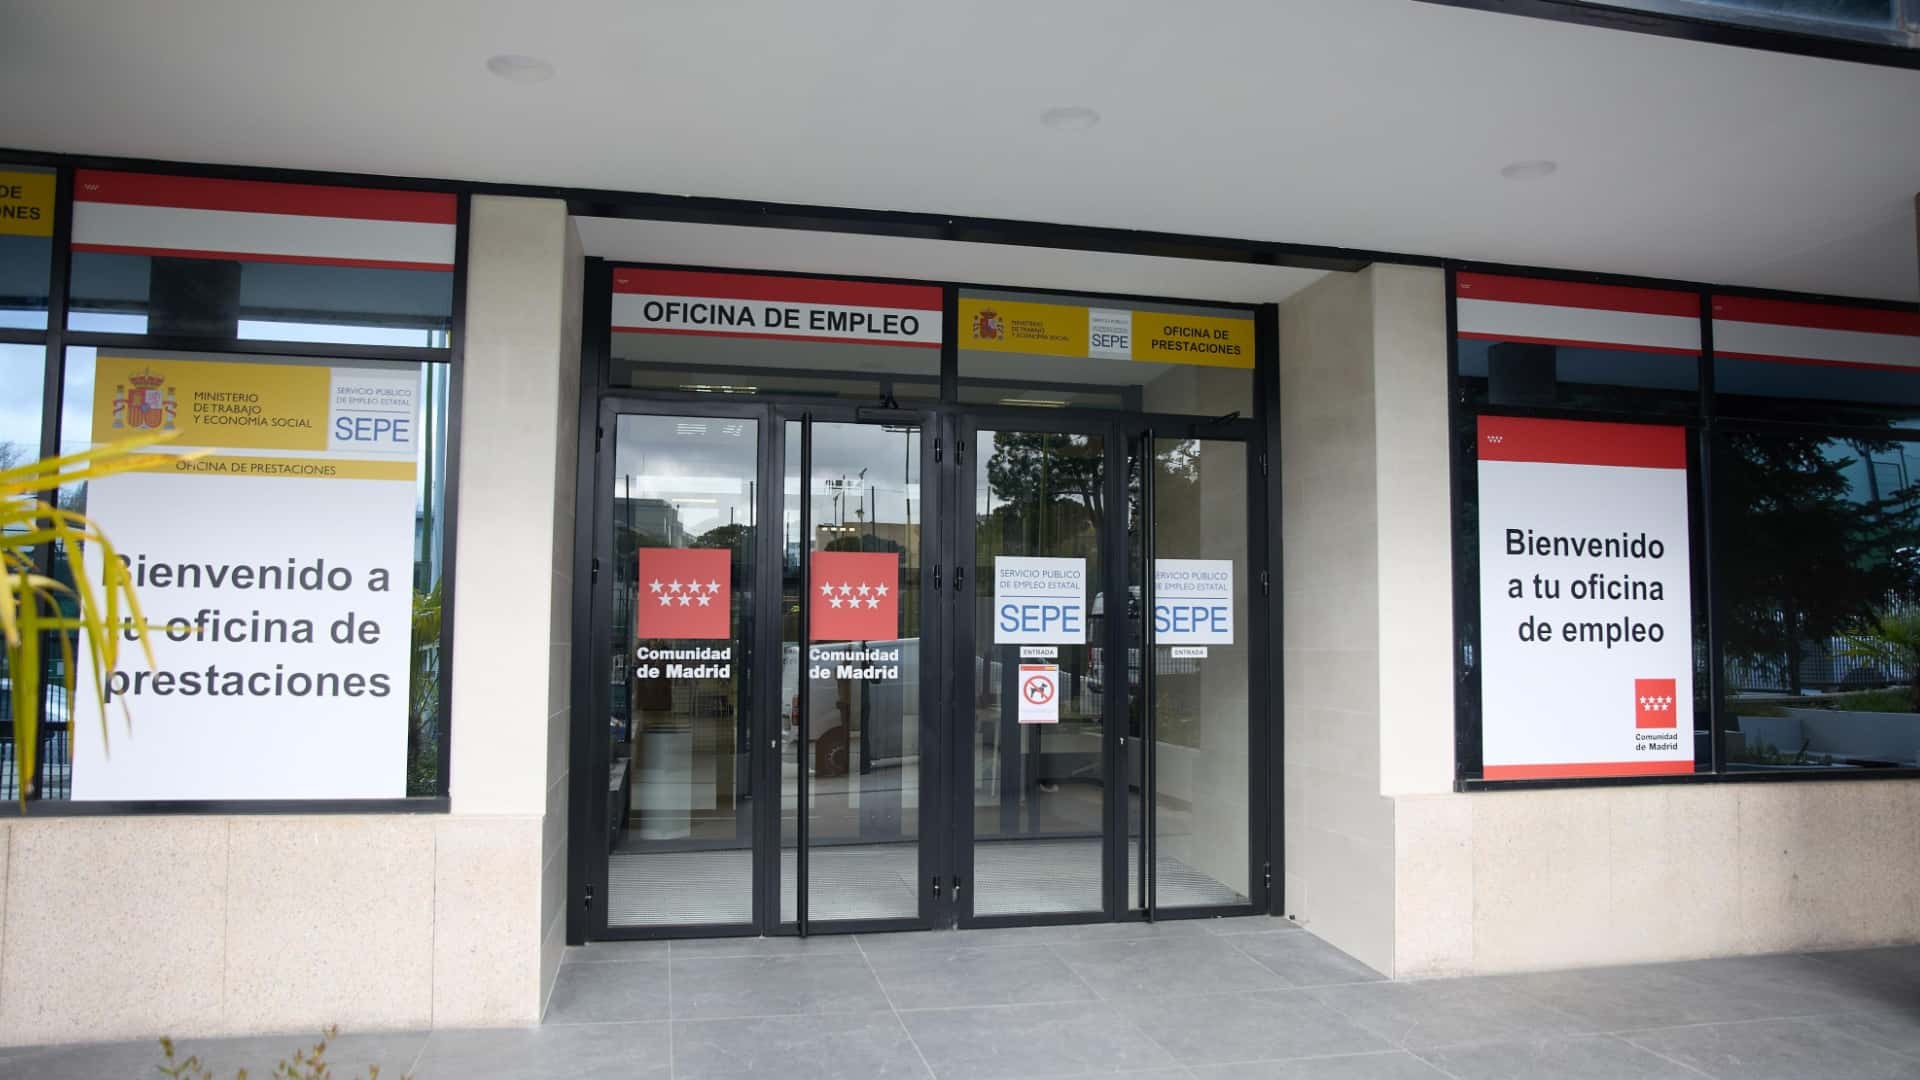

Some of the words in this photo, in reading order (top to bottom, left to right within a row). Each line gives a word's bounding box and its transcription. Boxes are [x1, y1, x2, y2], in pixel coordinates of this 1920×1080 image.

[643, 301, 755, 326] OFICINA
[765, 307, 800, 329] DE
[809, 309, 919, 336] EMPLEO
[1163, 325, 1210, 339] OFICINA
[1213, 328, 1229, 340] DE
[1091, 333, 1129, 349] SEPE
[1151, 339, 1241, 355] PRESTACIONES
[193, 391, 259, 403] MINISTERIO
[336, 386, 374, 396] SERVICIO
[336, 396, 347, 405] DE
[348, 397, 378, 406] EMPLEO
[193, 402, 209, 413] DE
[211, 403, 262, 416] TRABAJO
[193, 414, 201, 424] Y
[203, 414, 268, 426] ECONOMÍA
[271, 417, 312, 428] SOCIAL
[335, 416, 410, 442] SEPE
[231, 462, 248, 473] DE
[251, 463, 336, 476] PRESTACIONES
[1505, 528, 1665, 559] Bienvenido
[367, 566, 391, 592] a
[999, 569, 1040, 578] SERVICIO
[1155, 570, 1189, 580] ERVICIO
[1000, 581, 1011, 589] DE
[1013, 581, 1046, 590] EMPLEO
[1047, 581, 1081, 591] ESTATAL
[1164, 582, 1195, 591] EMPLEO
[1196, 582, 1229, 592] ESTATAL
[1508, 577, 1523, 599] a
[1533, 573, 1560, 599] tu
[1570, 573, 1664, 600] oficina
[1000, 604, 1081, 632] SEPE
[1155, 605, 1228, 633] SEPE
[165, 608, 314, 645] oficina
[330, 612, 381, 646] de
[1518, 615, 1552, 642] de
[1562, 616, 1664, 649] empleo
[636, 647, 732, 661] Comunidad
[809, 648, 899, 662] Comunidad
[1023, 648, 1055, 657] ENTRADA
[1174, 648, 1204, 657] ENTRADA
[636, 664, 660, 679] de
[665, 663, 731, 679] Madrid
[809, 665, 832, 680] de
[837, 664, 899, 680] Madrid
[103, 663, 391, 704] prestaciones
[1635, 733, 1678, 741] Comunidad
[1635, 743, 1647, 751] de
[1649, 742, 1678, 751] Madrid
